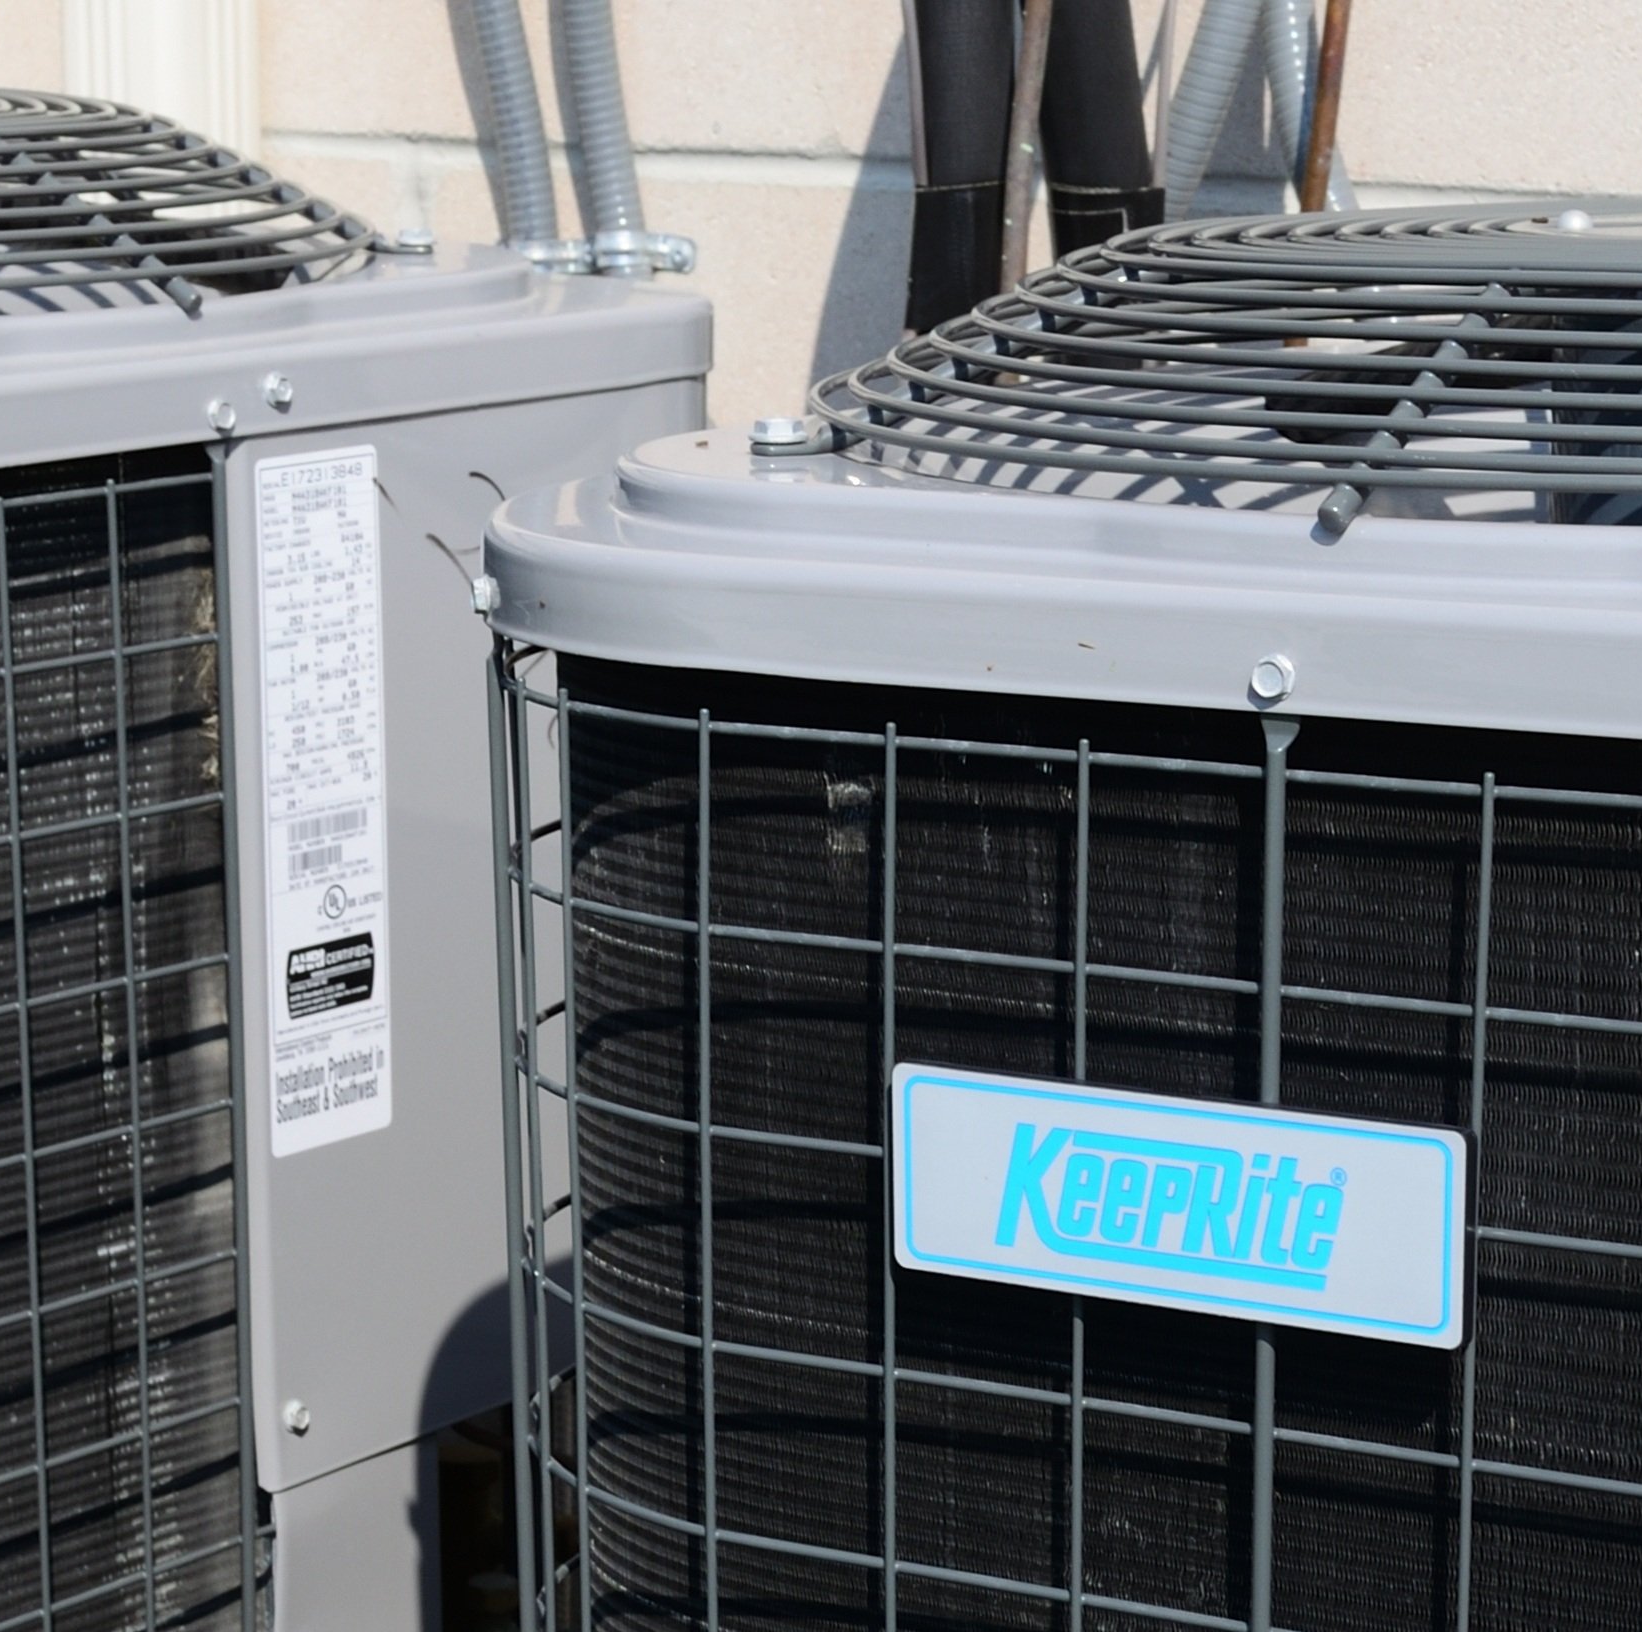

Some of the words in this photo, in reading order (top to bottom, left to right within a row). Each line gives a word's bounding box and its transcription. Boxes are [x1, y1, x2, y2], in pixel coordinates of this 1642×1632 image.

[275, 1062, 325, 1096] Installation
[328, 1045, 374, 1083] Prohibited
[375, 1044, 384, 1070] in
[276, 1087, 321, 1124] Southeast
[333, 1073, 378, 1109] Southwest
[995, 1123, 1345, 1291] KeepRite
